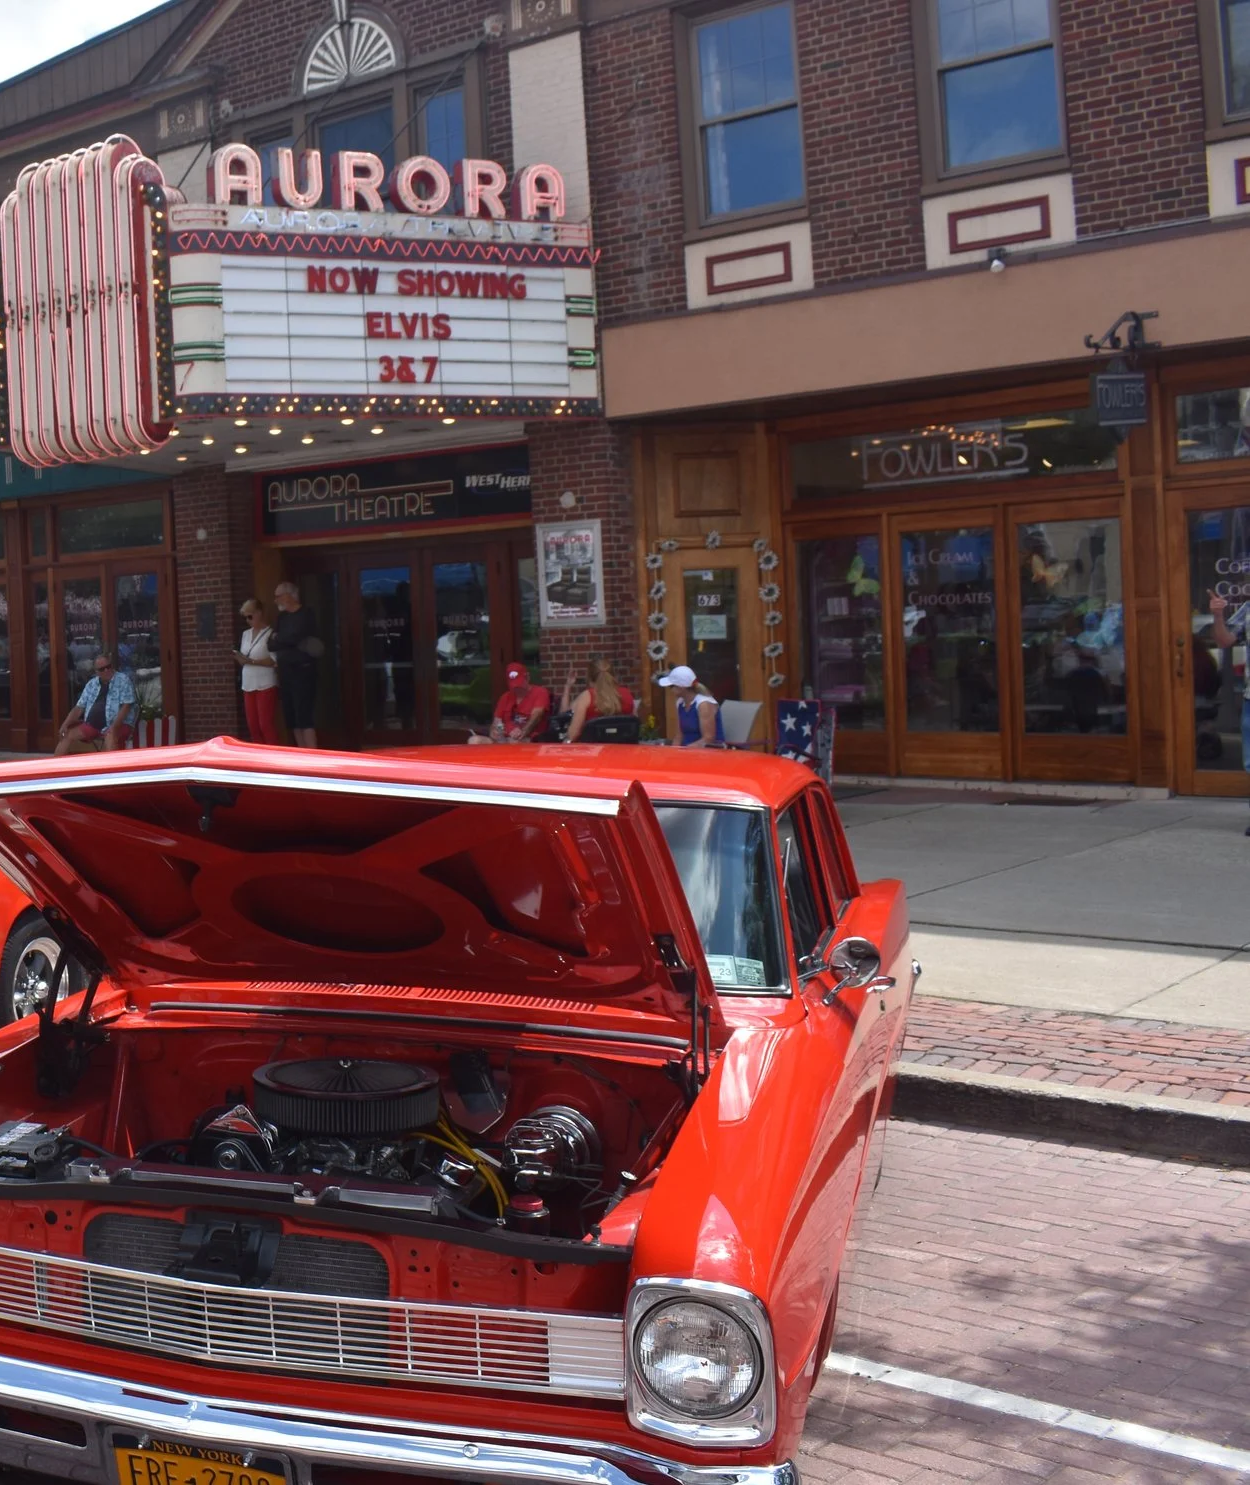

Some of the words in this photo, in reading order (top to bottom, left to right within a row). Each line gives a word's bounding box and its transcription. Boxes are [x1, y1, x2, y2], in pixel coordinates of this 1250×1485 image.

[207, 142, 565, 221] AURORA
[307, 265, 380, 295] NOW
[397, 268, 528, 300] SHOWING
[366, 311, 452, 340] ELVIS
[268, 473, 360, 508] AURORA
[335, 492, 435, 522] THEATRE
[699, 595, 719, 606] 673
[908, 590, 993, 606] CHOCOLATES
[152, 1439, 194, 1458] NEW
[196, 1447, 243, 1467] YORK
